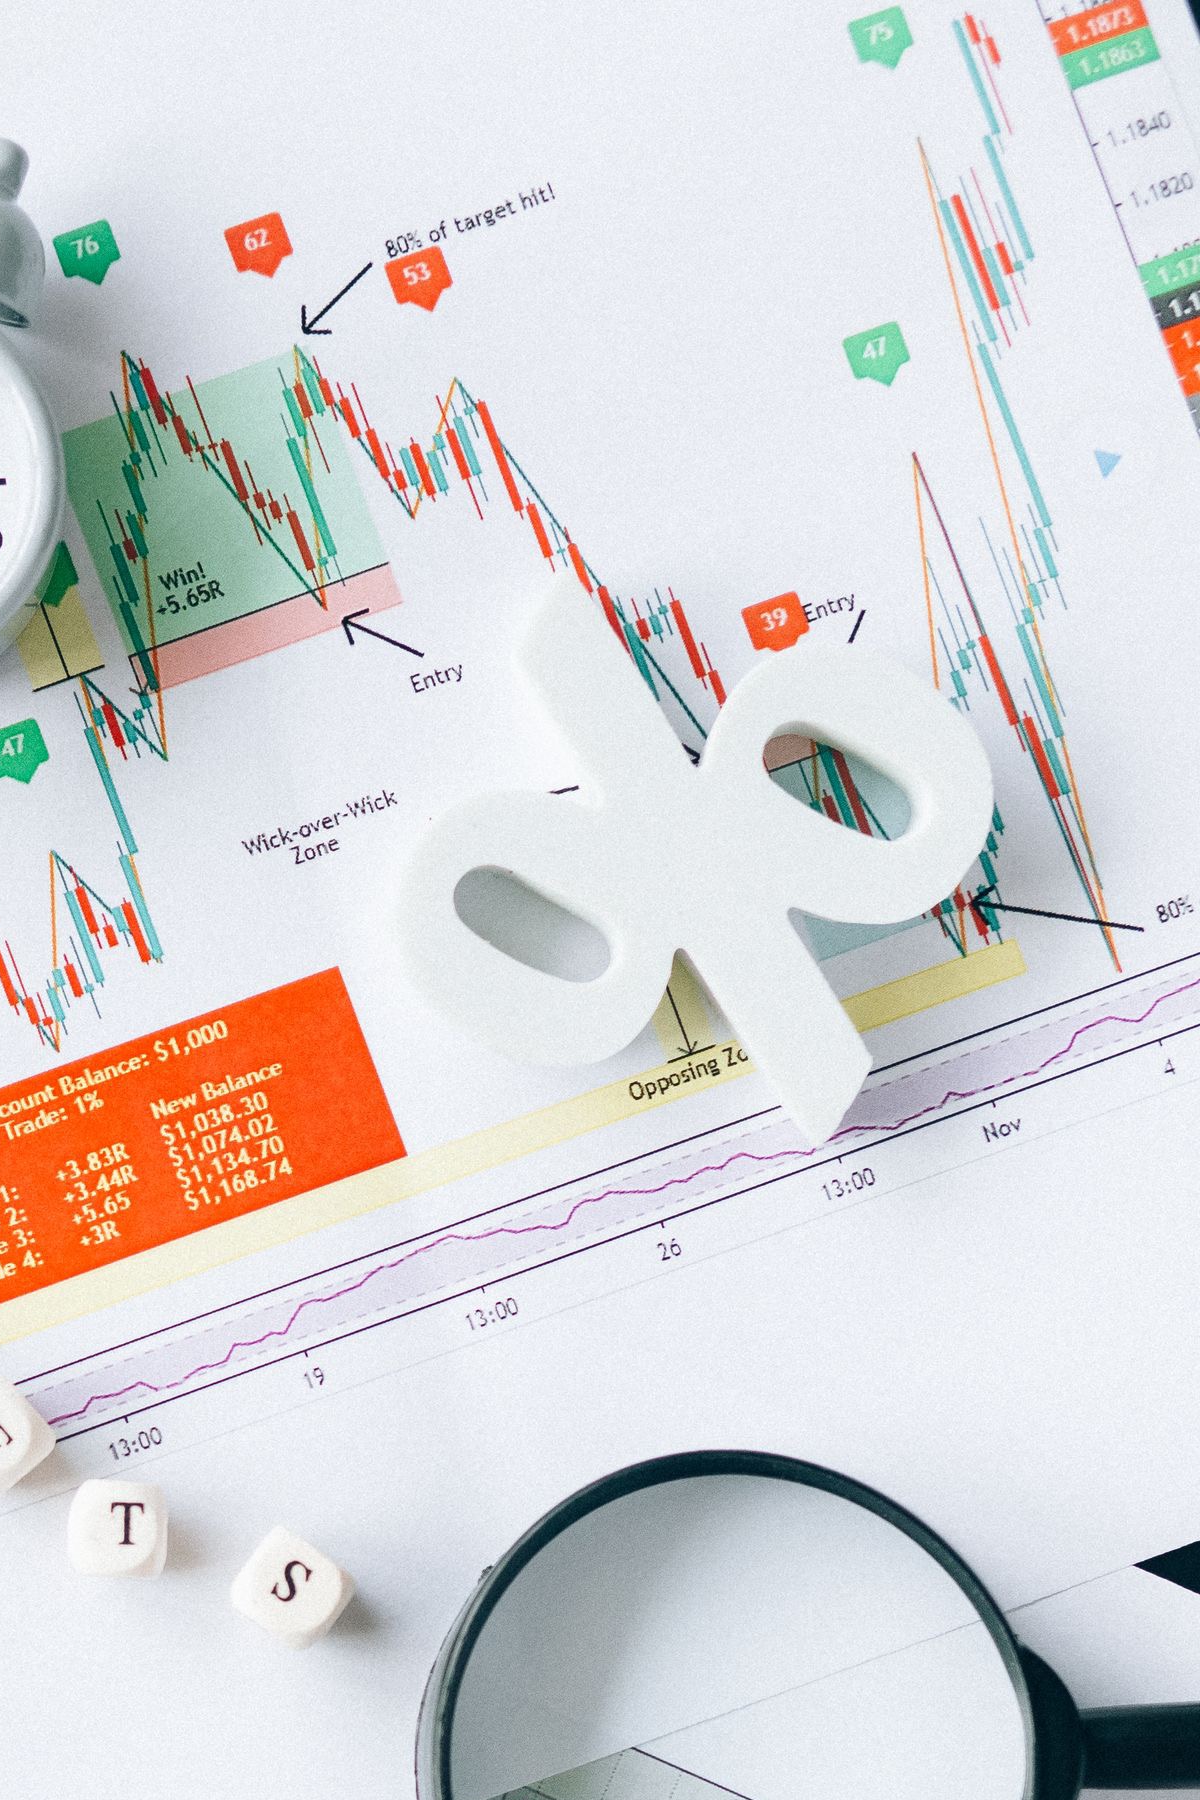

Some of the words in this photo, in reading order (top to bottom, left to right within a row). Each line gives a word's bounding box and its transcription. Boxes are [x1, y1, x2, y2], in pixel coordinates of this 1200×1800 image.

[864, 20, 894, 46] 75
[1107, 110, 1171, 144] 1.1840
[1130, 171, 1194, 208] 1.1820
[384, 232, 423, 259] 80%
[428, 220, 447, 243] of
[454, 201, 517, 233] target
[518, 182, 556, 210] hit!
[69, 235, 100, 259] 76
[244, 228, 272, 252] 62
[402, 261, 432, 286] 53
[862, 336, 886, 360] 47
[157, 561, 207, 591] Win!
[156, 579, 225, 616] +5.65R
[802, 593, 855, 623] Entry
[760, 607, 789, 632] 39
[409, 664, 463, 694] Entry
[1, 733, 25, 757] 47
[241, 789, 398, 855] Wick-over-Wick
[289, 838, 340, 865] Zone
[1155, 897, 1194, 924] 80%
[58, 1053, 150, 1096] Balance:
[153, 1019, 229, 1062] $1,000
[1164, 1058, 1176, 1075] 4
[149, 1093, 197, 1120] New
[200, 1063, 283, 1102] Balance
[628, 1058, 721, 1101] Opposing
[0, 1107, 69, 1141] Trade:
[73, 1089, 105, 1114] 1%
[982, 1118, 1021, 1143] Nov
[56, 1142, 130, 1181] +3.83R
[159, 1091, 269, 1146] $1,038.30
[4, 1206, 28, 1227] 2:
[63, 1164, 139, 1203] +3.44R
[167, 1113, 278, 1168] $1,074.02
[822, 1167, 876, 1201] 13:00
[12, 1228, 36, 1248] 3:
[72, 1190, 131, 1225] +5.65
[175, 1135, 285, 1189] $1,134.70
[22, 1249, 44, 1268] 4:
[80, 1220, 121, 1246] +3R
[183, 1156, 293, 1211] $1,168.74
[656, 1237, 682, 1262] 26
[465, 1296, 519, 1331] 13:00
[303, 1366, 325, 1388] 19
[108, 1426, 162, 1460] 13:00
